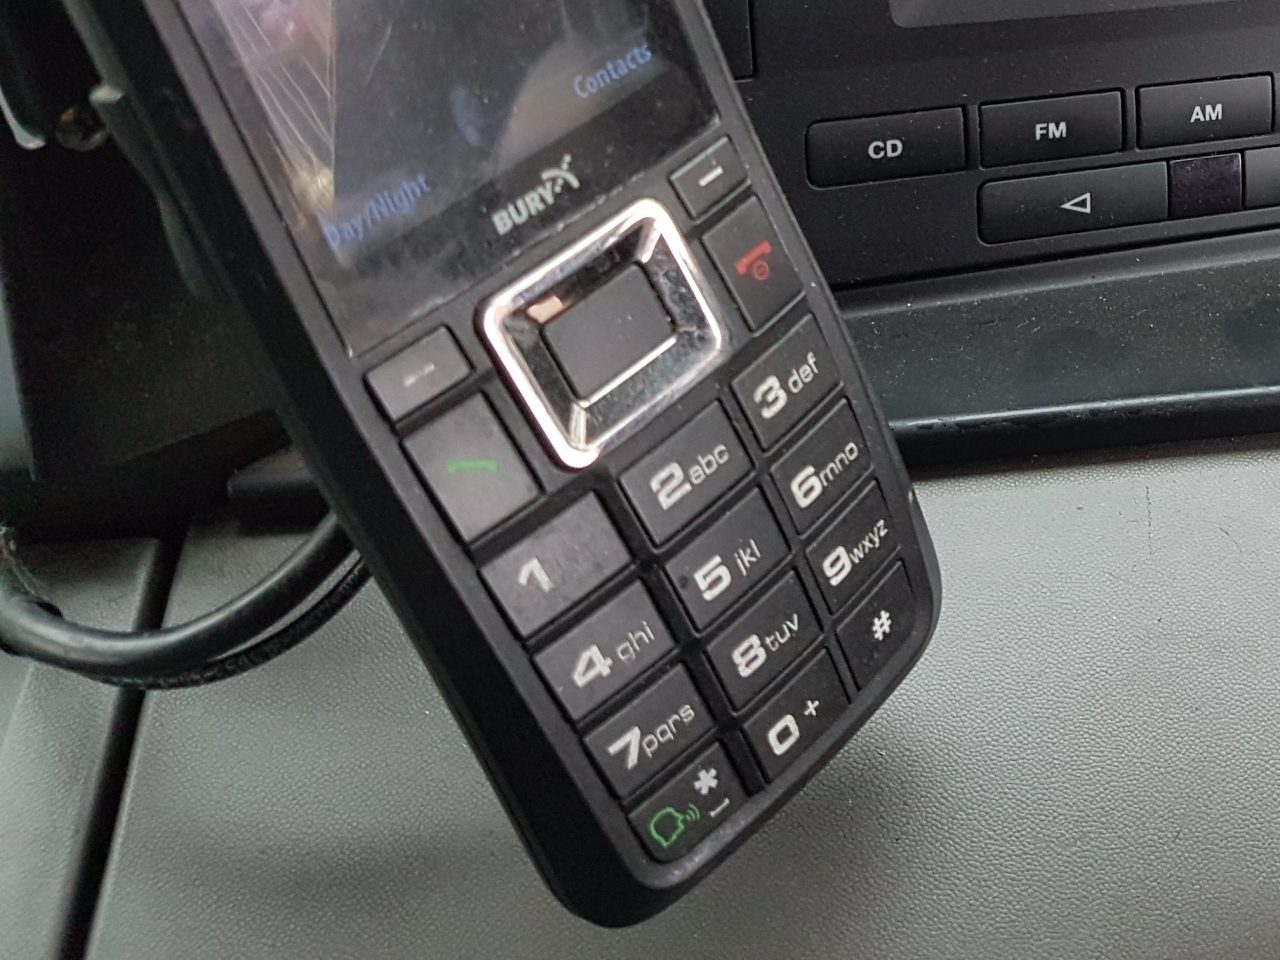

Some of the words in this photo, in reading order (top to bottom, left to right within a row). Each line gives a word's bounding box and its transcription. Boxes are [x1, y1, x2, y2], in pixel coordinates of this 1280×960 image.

[573, 42, 652, 99] Contacts
[1035, 121, 1067, 140] FM
[1190, 103, 1223, 123] AM
[868, 139, 903, 159] CD
[320, 174, 432, 251] Day/Night
[753, 375, 788, 420] 3
[517, 557, 555, 593] 1
[694, 554, 732, 602] 5
[572, 644, 613, 688] 4
